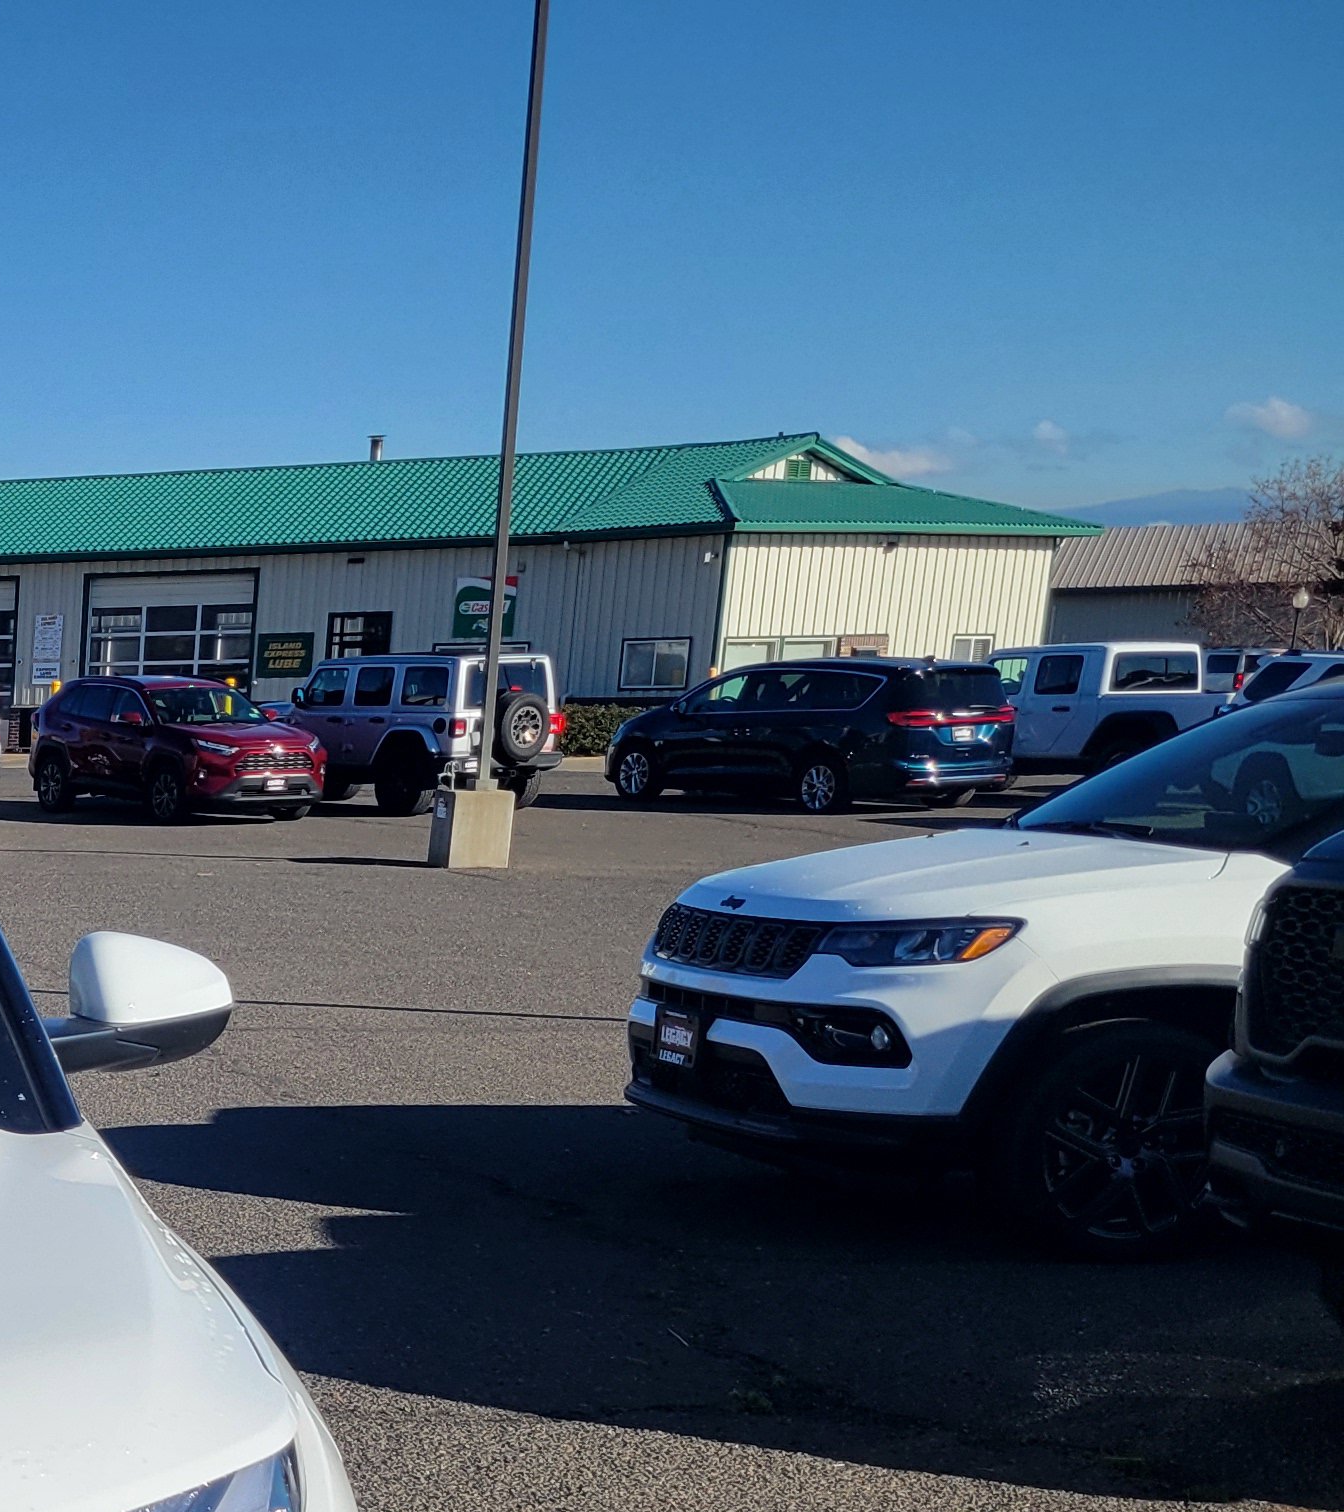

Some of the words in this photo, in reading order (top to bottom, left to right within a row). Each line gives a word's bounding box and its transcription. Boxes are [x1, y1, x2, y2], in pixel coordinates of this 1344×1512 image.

[472, 601, 507, 613] Casl
[268, 642, 303, 650] ISLAND
[267, 659, 302, 669] LUBE
[661, 1025, 693, 1048] LEGACY
[659, 1049, 685, 1066] LEGACY
